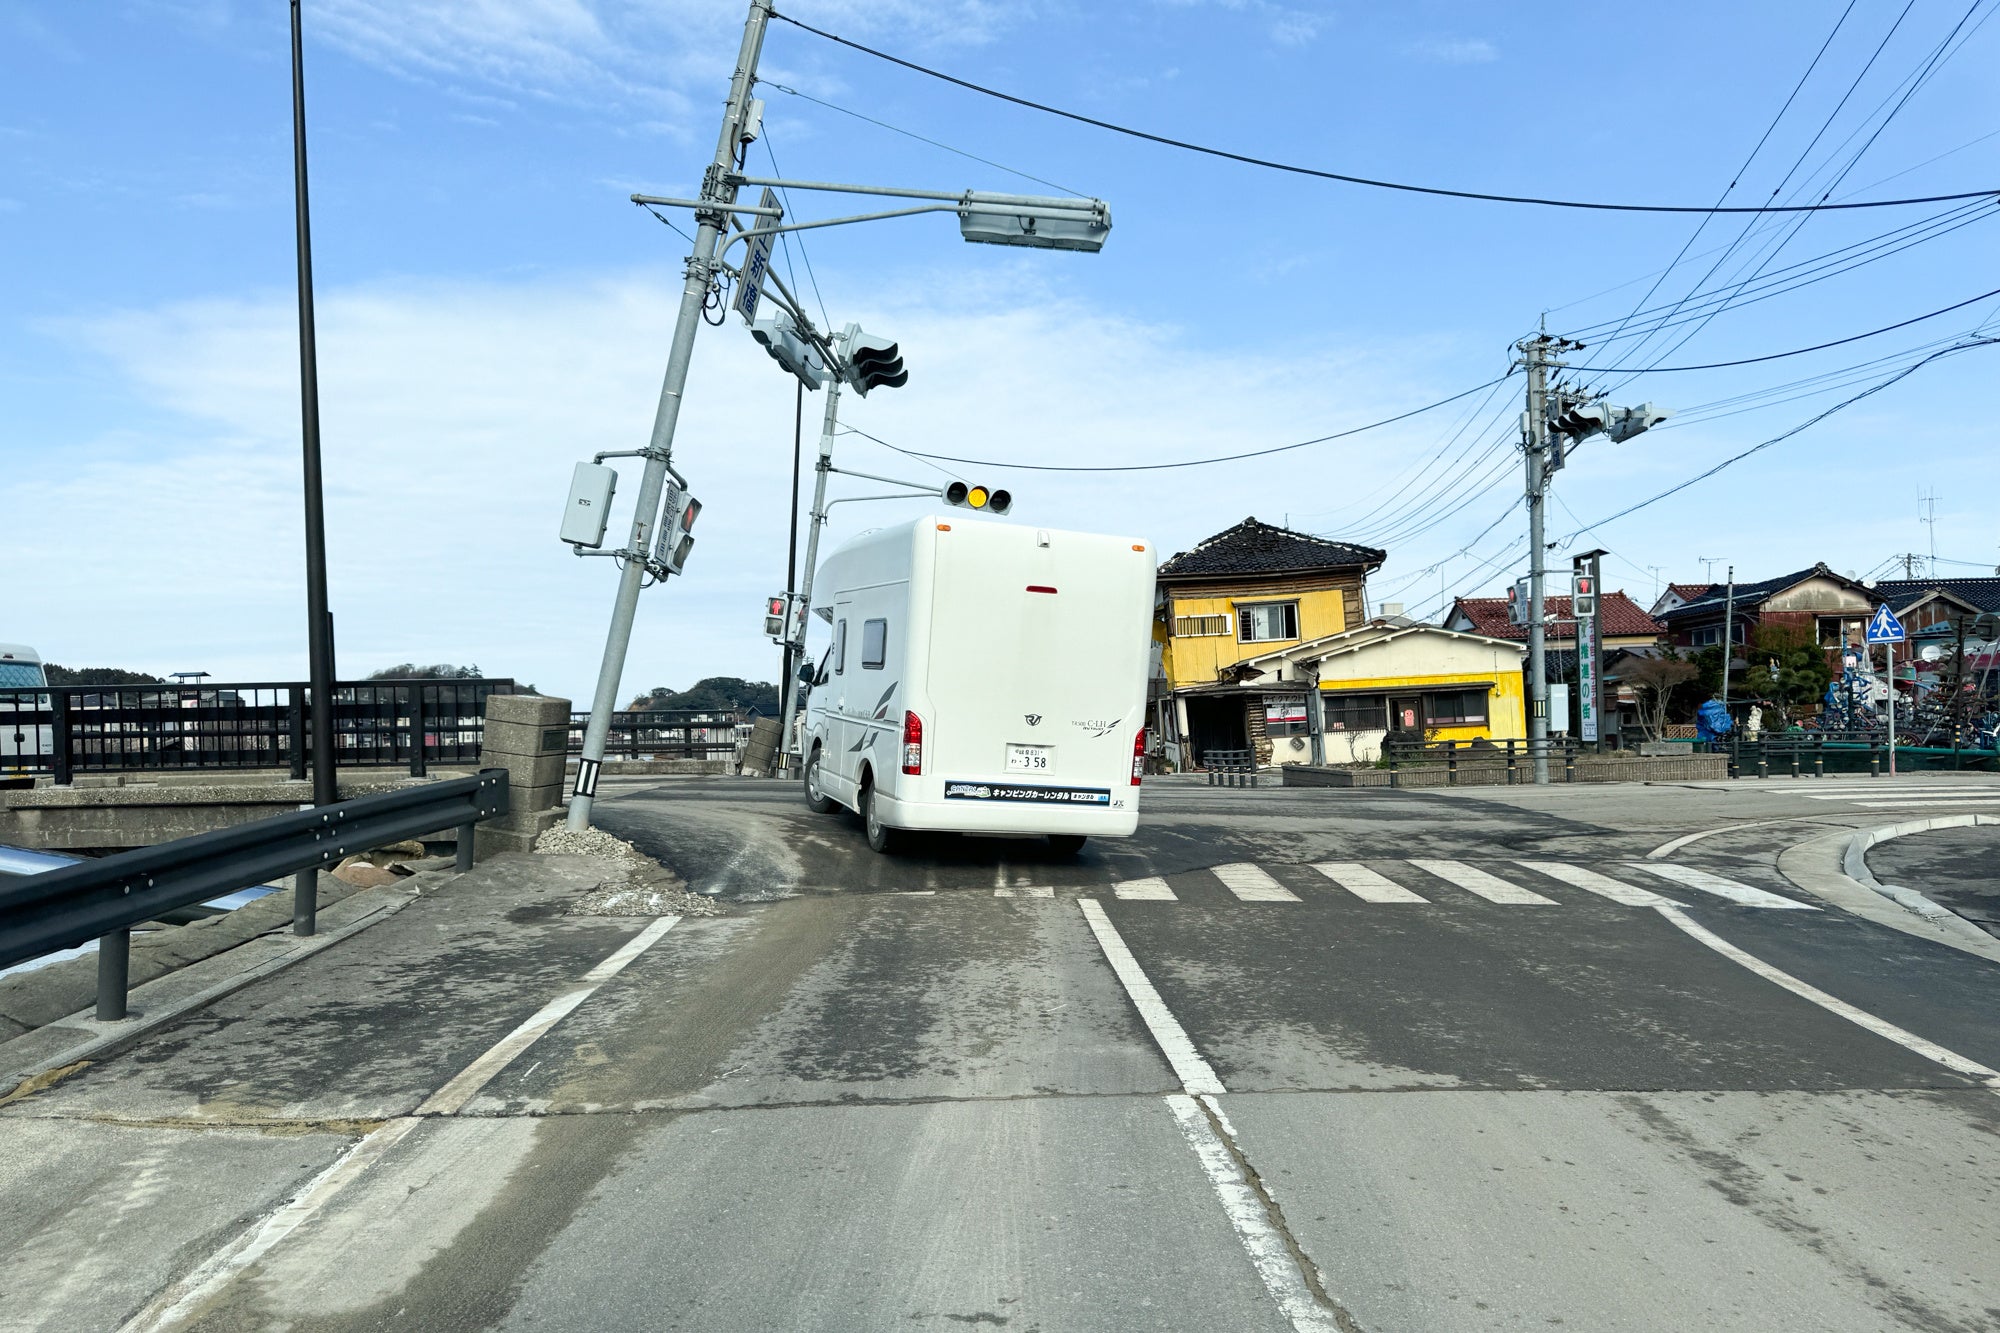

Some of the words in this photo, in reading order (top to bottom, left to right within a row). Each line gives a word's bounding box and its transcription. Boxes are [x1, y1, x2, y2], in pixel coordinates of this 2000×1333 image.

[992, 788, 1070, 800] キャンピングカーレンタル
